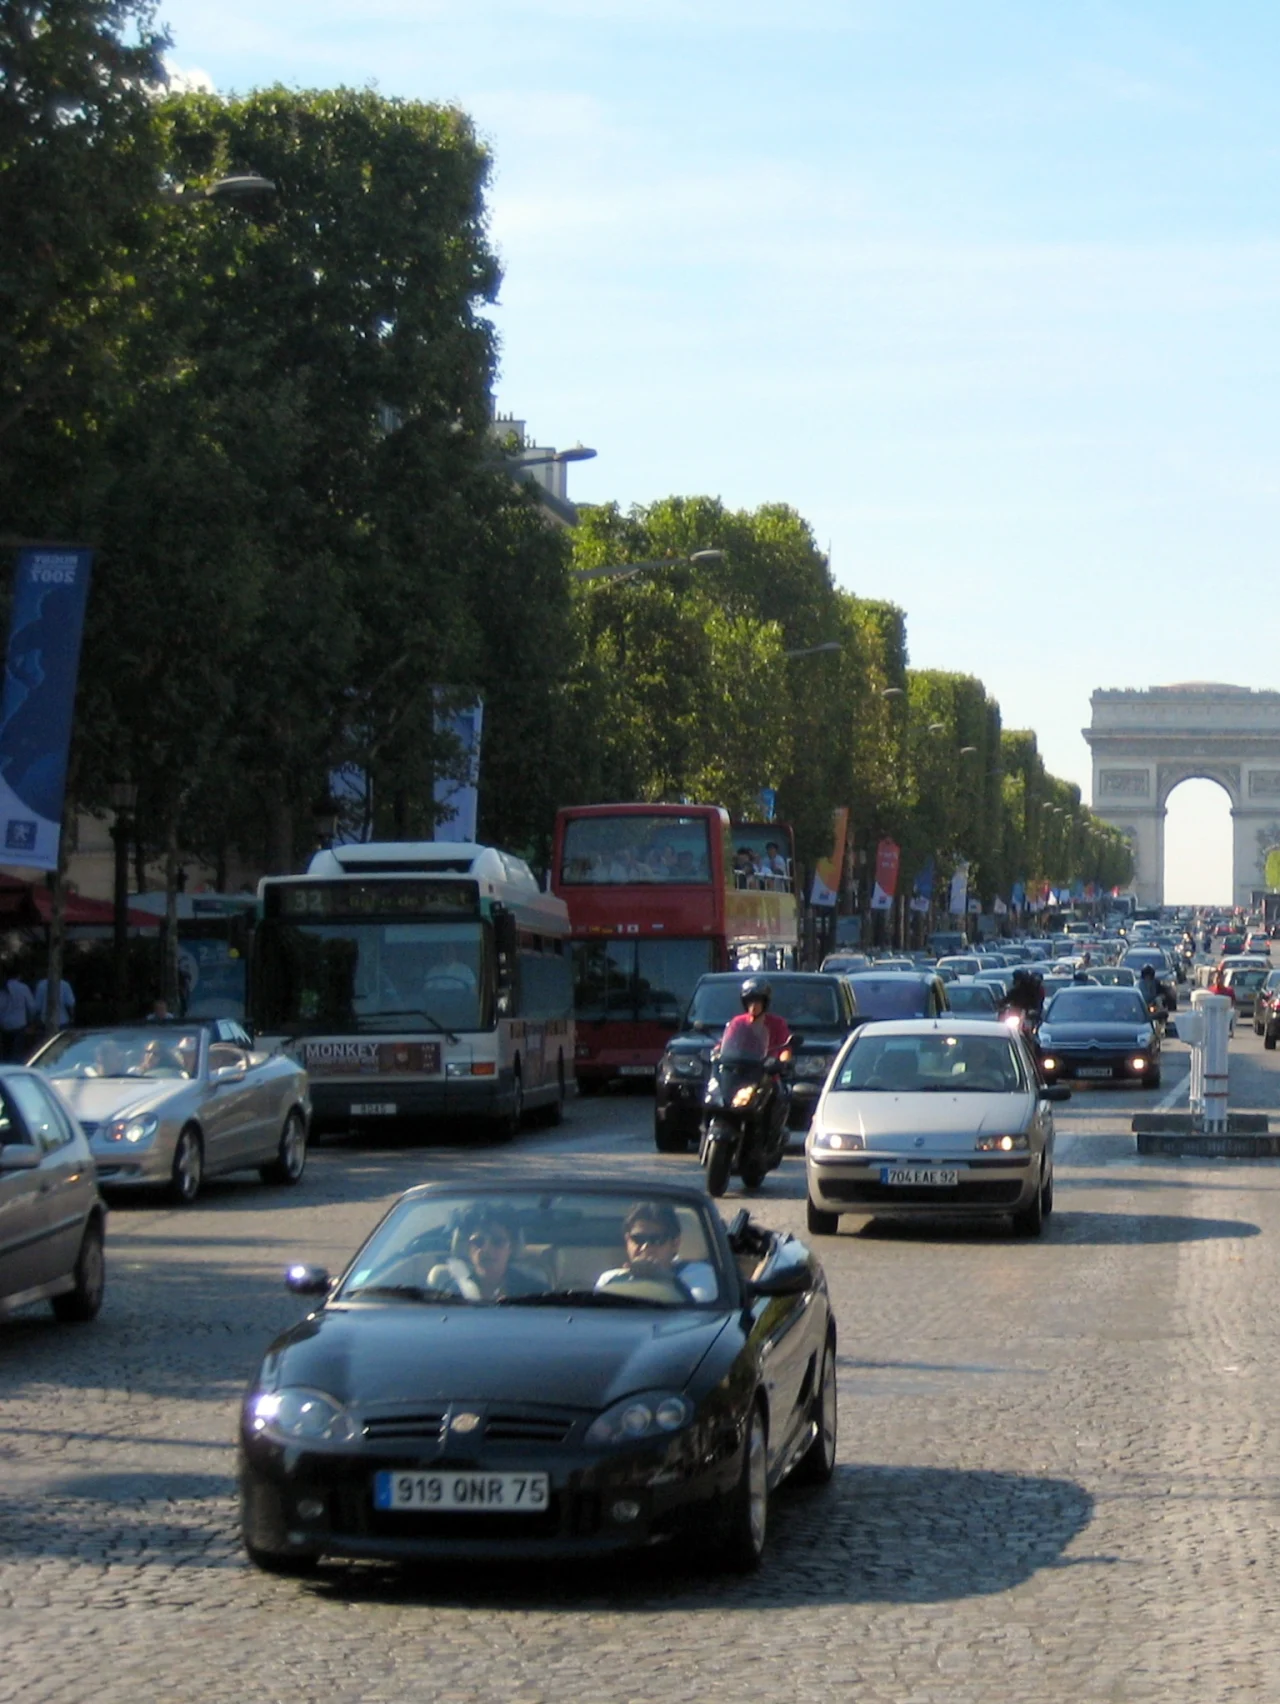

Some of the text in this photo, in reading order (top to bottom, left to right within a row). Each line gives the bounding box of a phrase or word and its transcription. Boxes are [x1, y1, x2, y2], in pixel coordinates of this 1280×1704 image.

[295, 890, 323, 911] 32
[306, 1044, 379, 1057] MONKEY
[889, 1170, 912, 1182] 704
[940, 1170, 956, 1182] 92
[398, 1477, 546, 1504] 919 QNR 75
